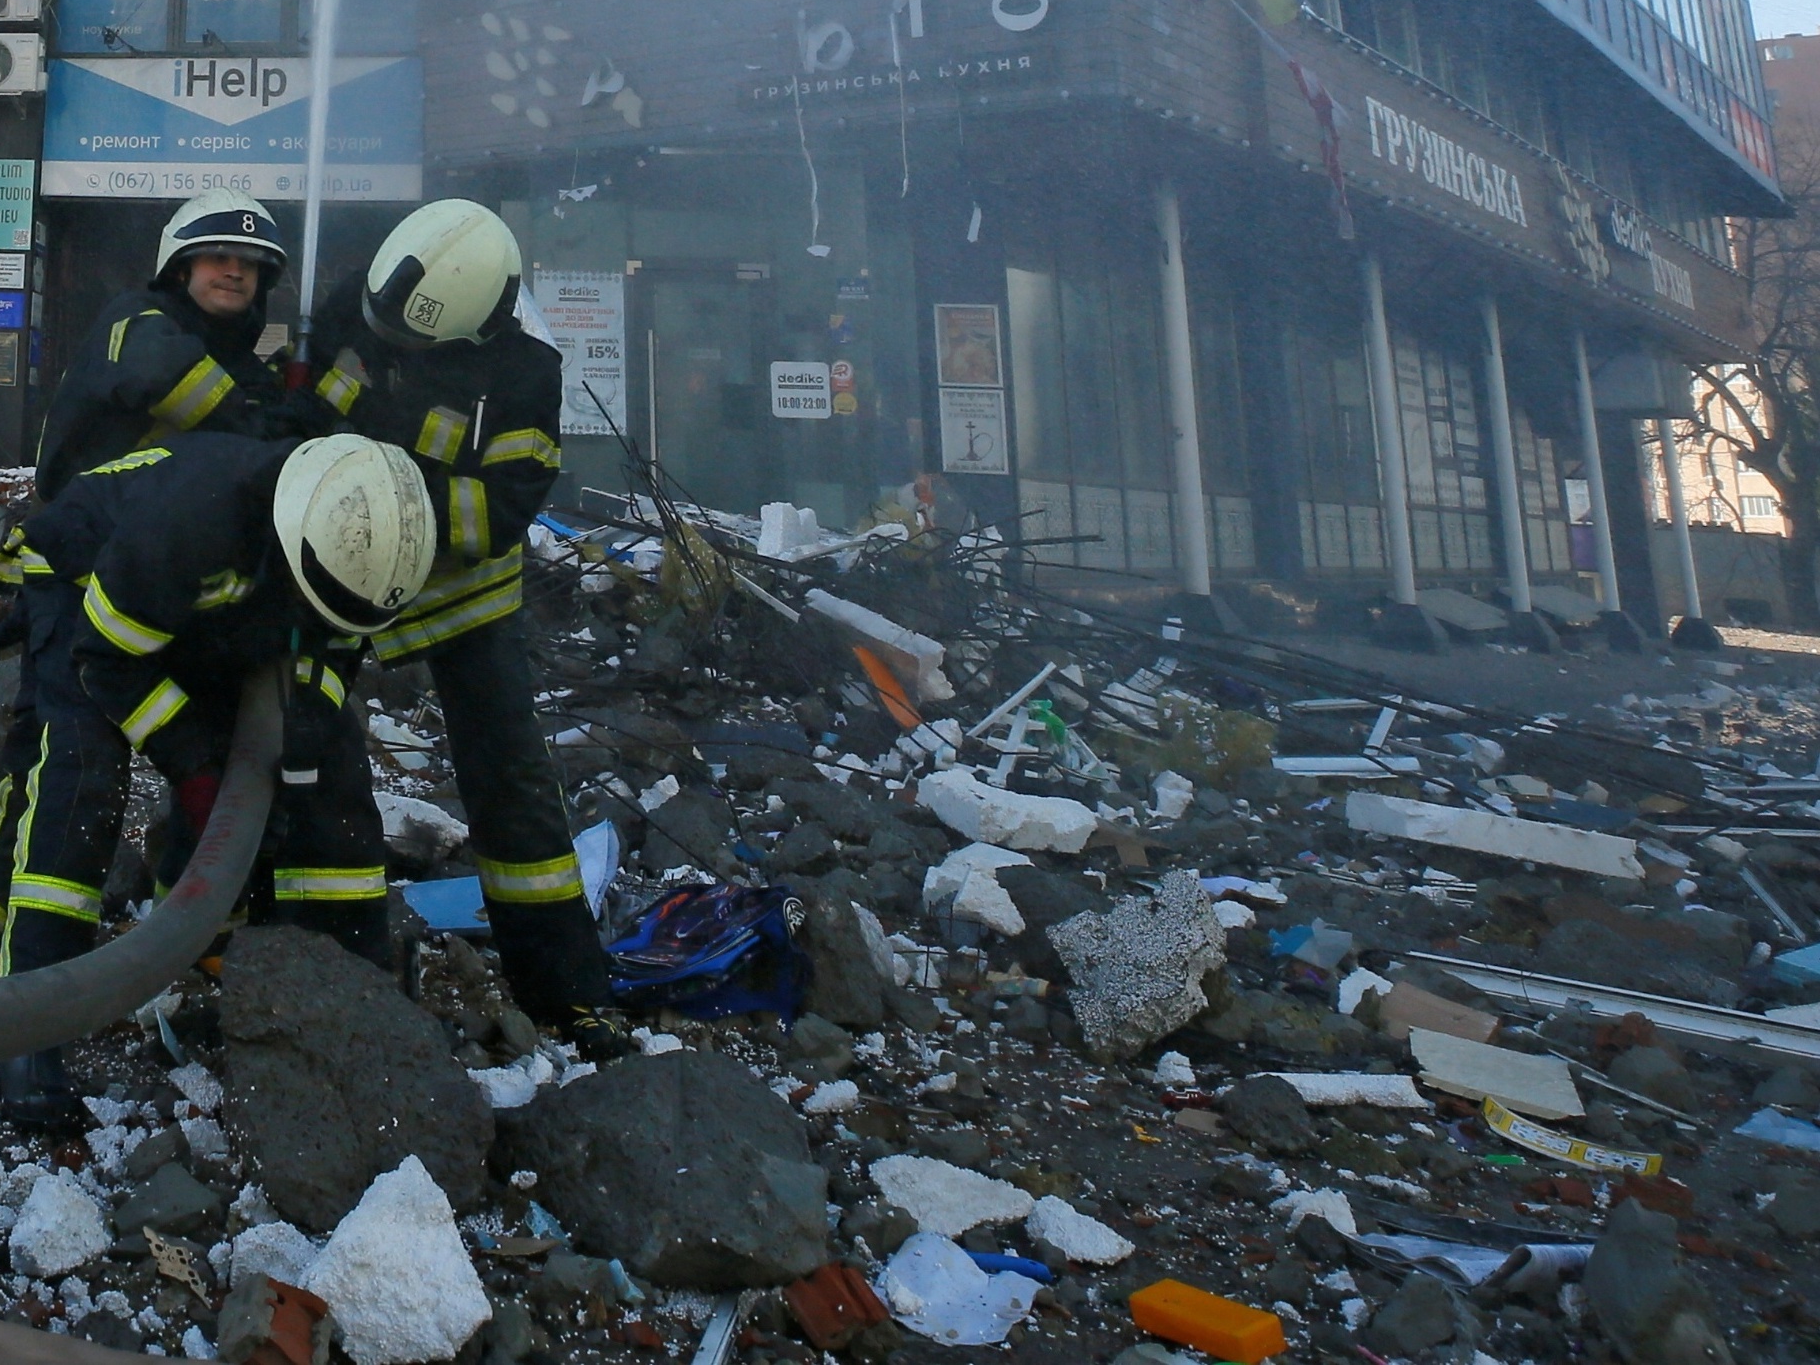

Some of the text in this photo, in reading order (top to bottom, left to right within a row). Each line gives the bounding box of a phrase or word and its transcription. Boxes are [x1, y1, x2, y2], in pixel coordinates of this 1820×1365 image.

[173, 57, 288, 107] iHelp
[753, 69, 921, 100] ГРУЗИНСЬКА
[92, 134, 161, 152] ремонт
[190, 133, 251, 152] сервіс
[1365, 95, 1528, 228] ГРУЗИНСЬКА
[107, 171, 155, 194] (067)
[162, 174, 194, 190] 156
[201, 173, 222, 190] 50
[230, 173, 252, 190] 66
[241, 214, 256, 233] 8
[558, 286, 600, 297] dediko
[420, 297, 437, 313] 26
[415, 309, 432, 323] 23
[586, 345, 620, 359] 15%
[777, 373, 824, 384] dediko
[777, 397, 827, 410] 10:00-23:00
[383, 586, 405, 609] 8
